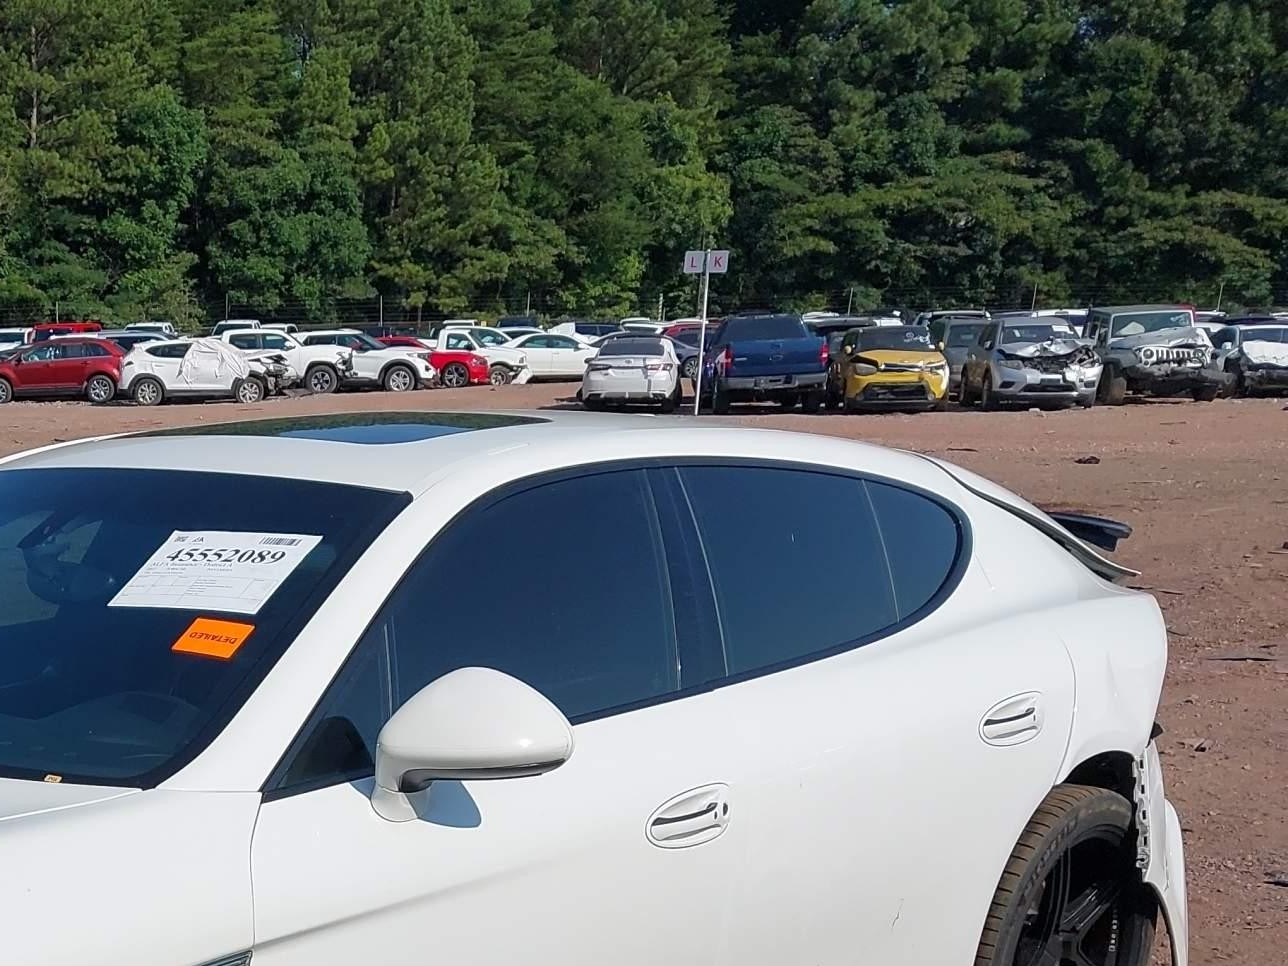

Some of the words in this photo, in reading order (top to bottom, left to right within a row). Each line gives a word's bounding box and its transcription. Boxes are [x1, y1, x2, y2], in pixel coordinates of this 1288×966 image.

[691, 256, 696, 268] L
[714, 256, 722, 268] K
[166, 548, 286, 565] 45552089
[189, 632, 238, 645] DETAILED
